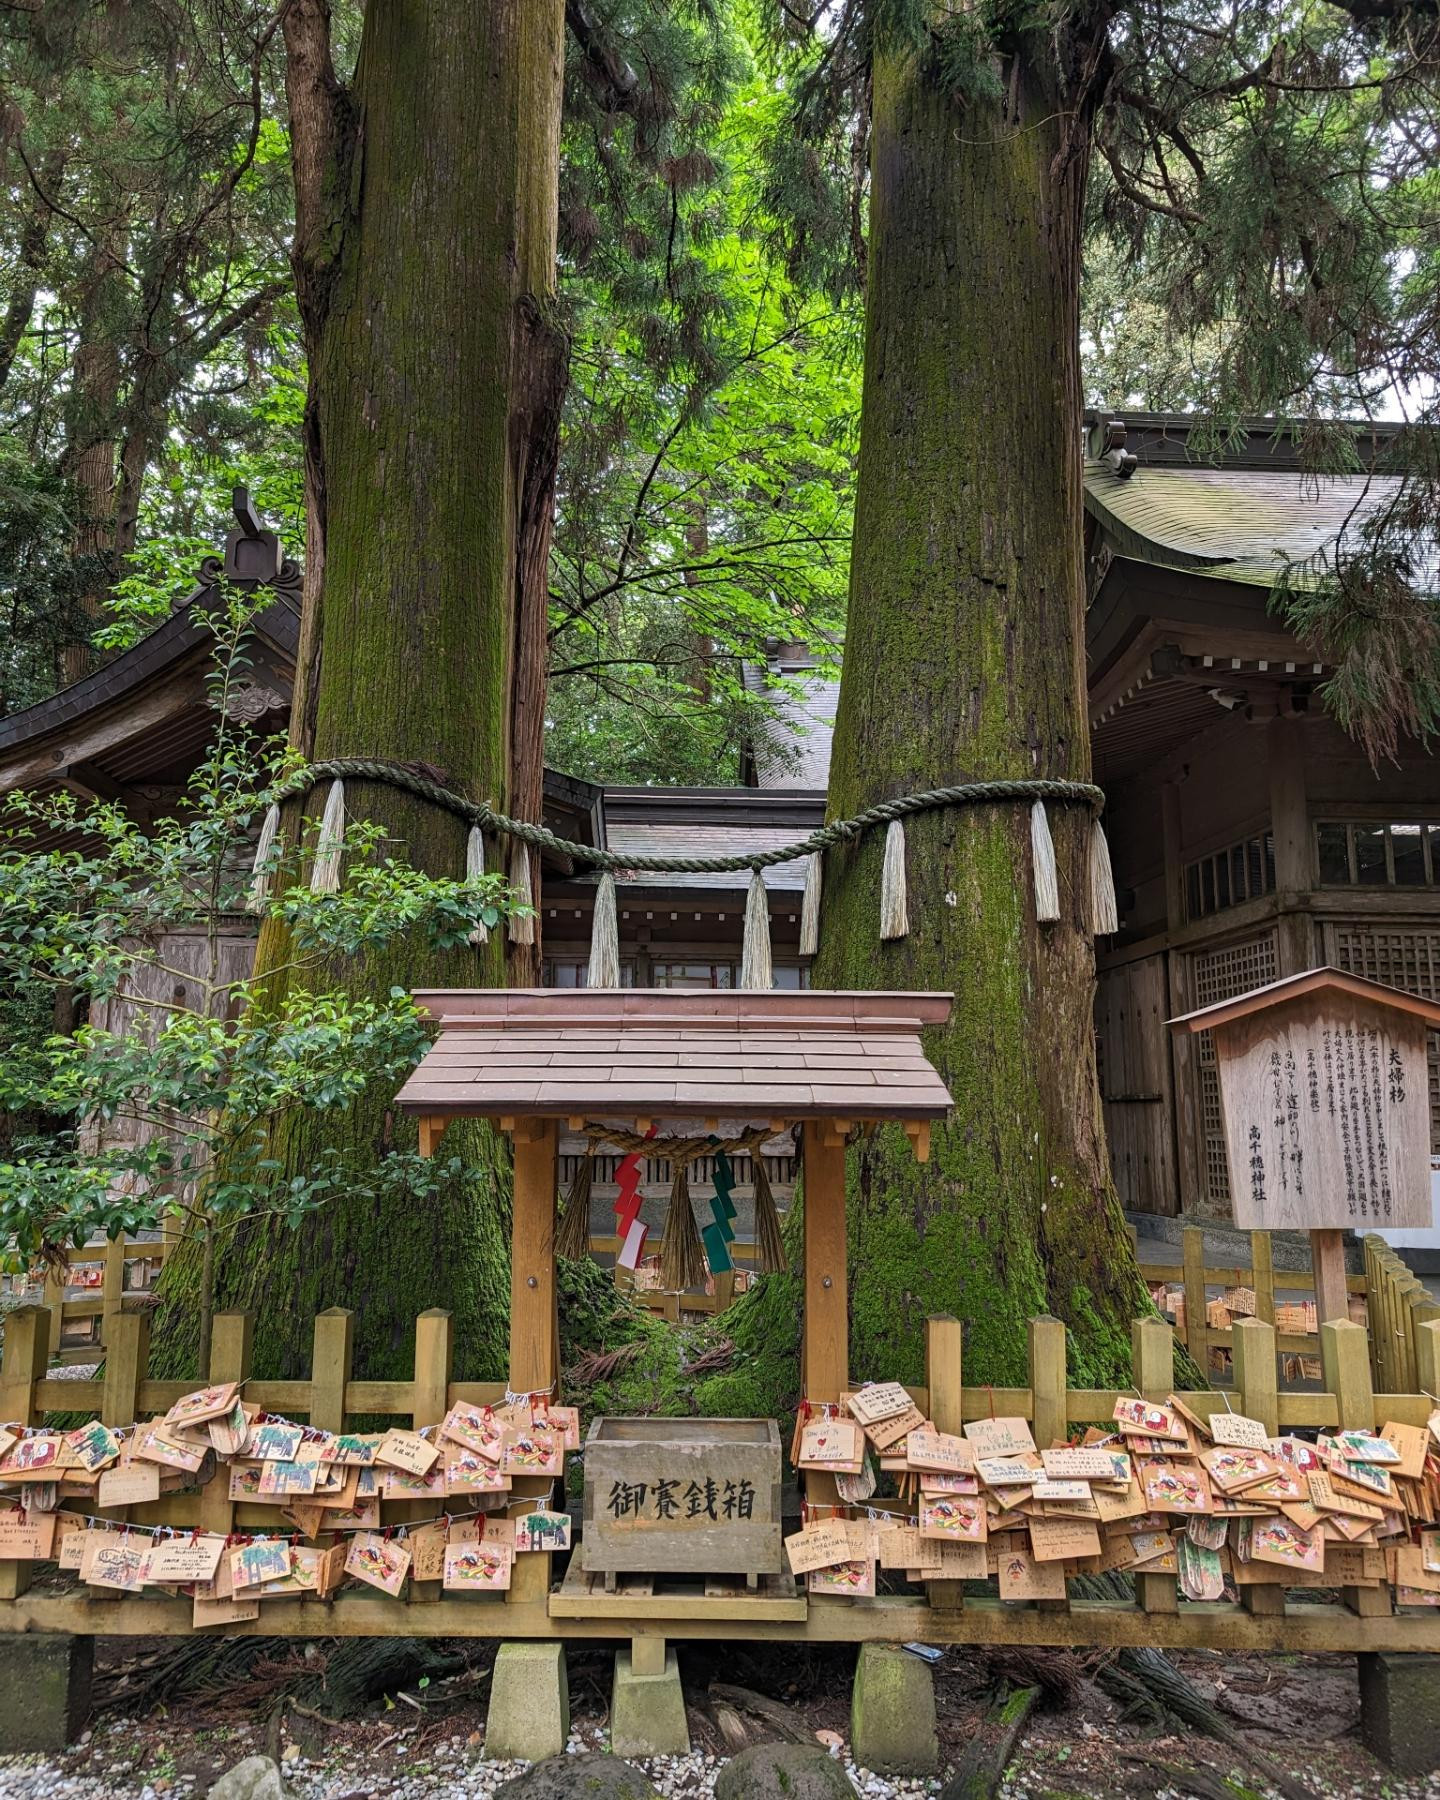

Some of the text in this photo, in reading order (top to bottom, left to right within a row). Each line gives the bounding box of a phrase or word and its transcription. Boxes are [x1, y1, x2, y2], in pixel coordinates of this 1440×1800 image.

[1388, 1048, 1406, 1103] 夫婦杉
[1248, 1124, 1268, 1202] 高千穂神社
[606, 1475, 756, 1521] 御賽銭箱
